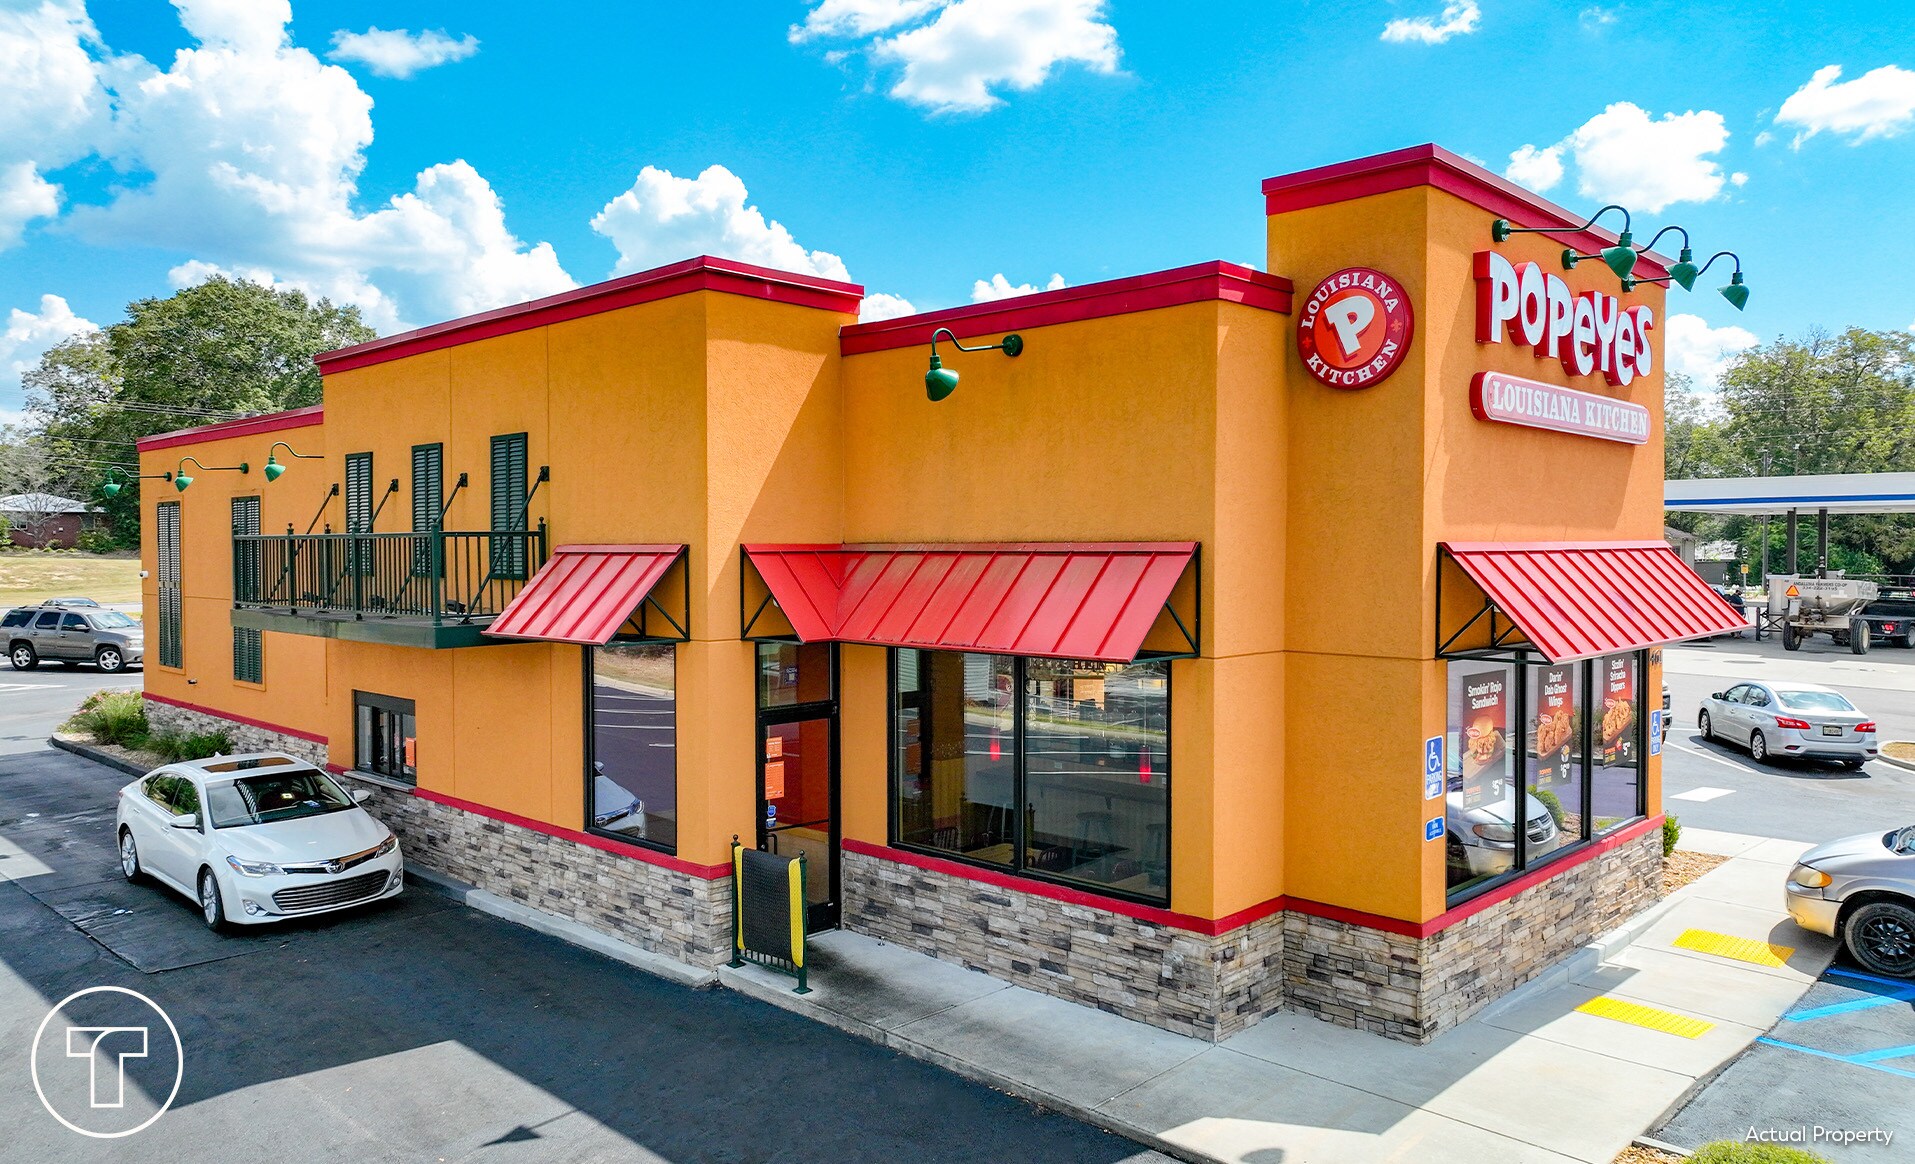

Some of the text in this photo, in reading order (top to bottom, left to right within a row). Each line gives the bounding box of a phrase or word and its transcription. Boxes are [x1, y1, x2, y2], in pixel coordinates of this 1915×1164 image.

[1301, 272, 1399, 329] LOUISIANA
[1323, 295, 1375, 356] P
[1306, 338, 1398, 385] KITCHEN
[1492, 380, 1648, 436] LOUISIANA KITCHEN
[1467, 682, 1490, 697] Smokin'
[1554, 683, 1567, 694] Ghost
[1610, 682, 1626, 693] Dippers
[1471, 694, 1499, 709] Sandwich
[1548, 696, 1563, 708] Wings
